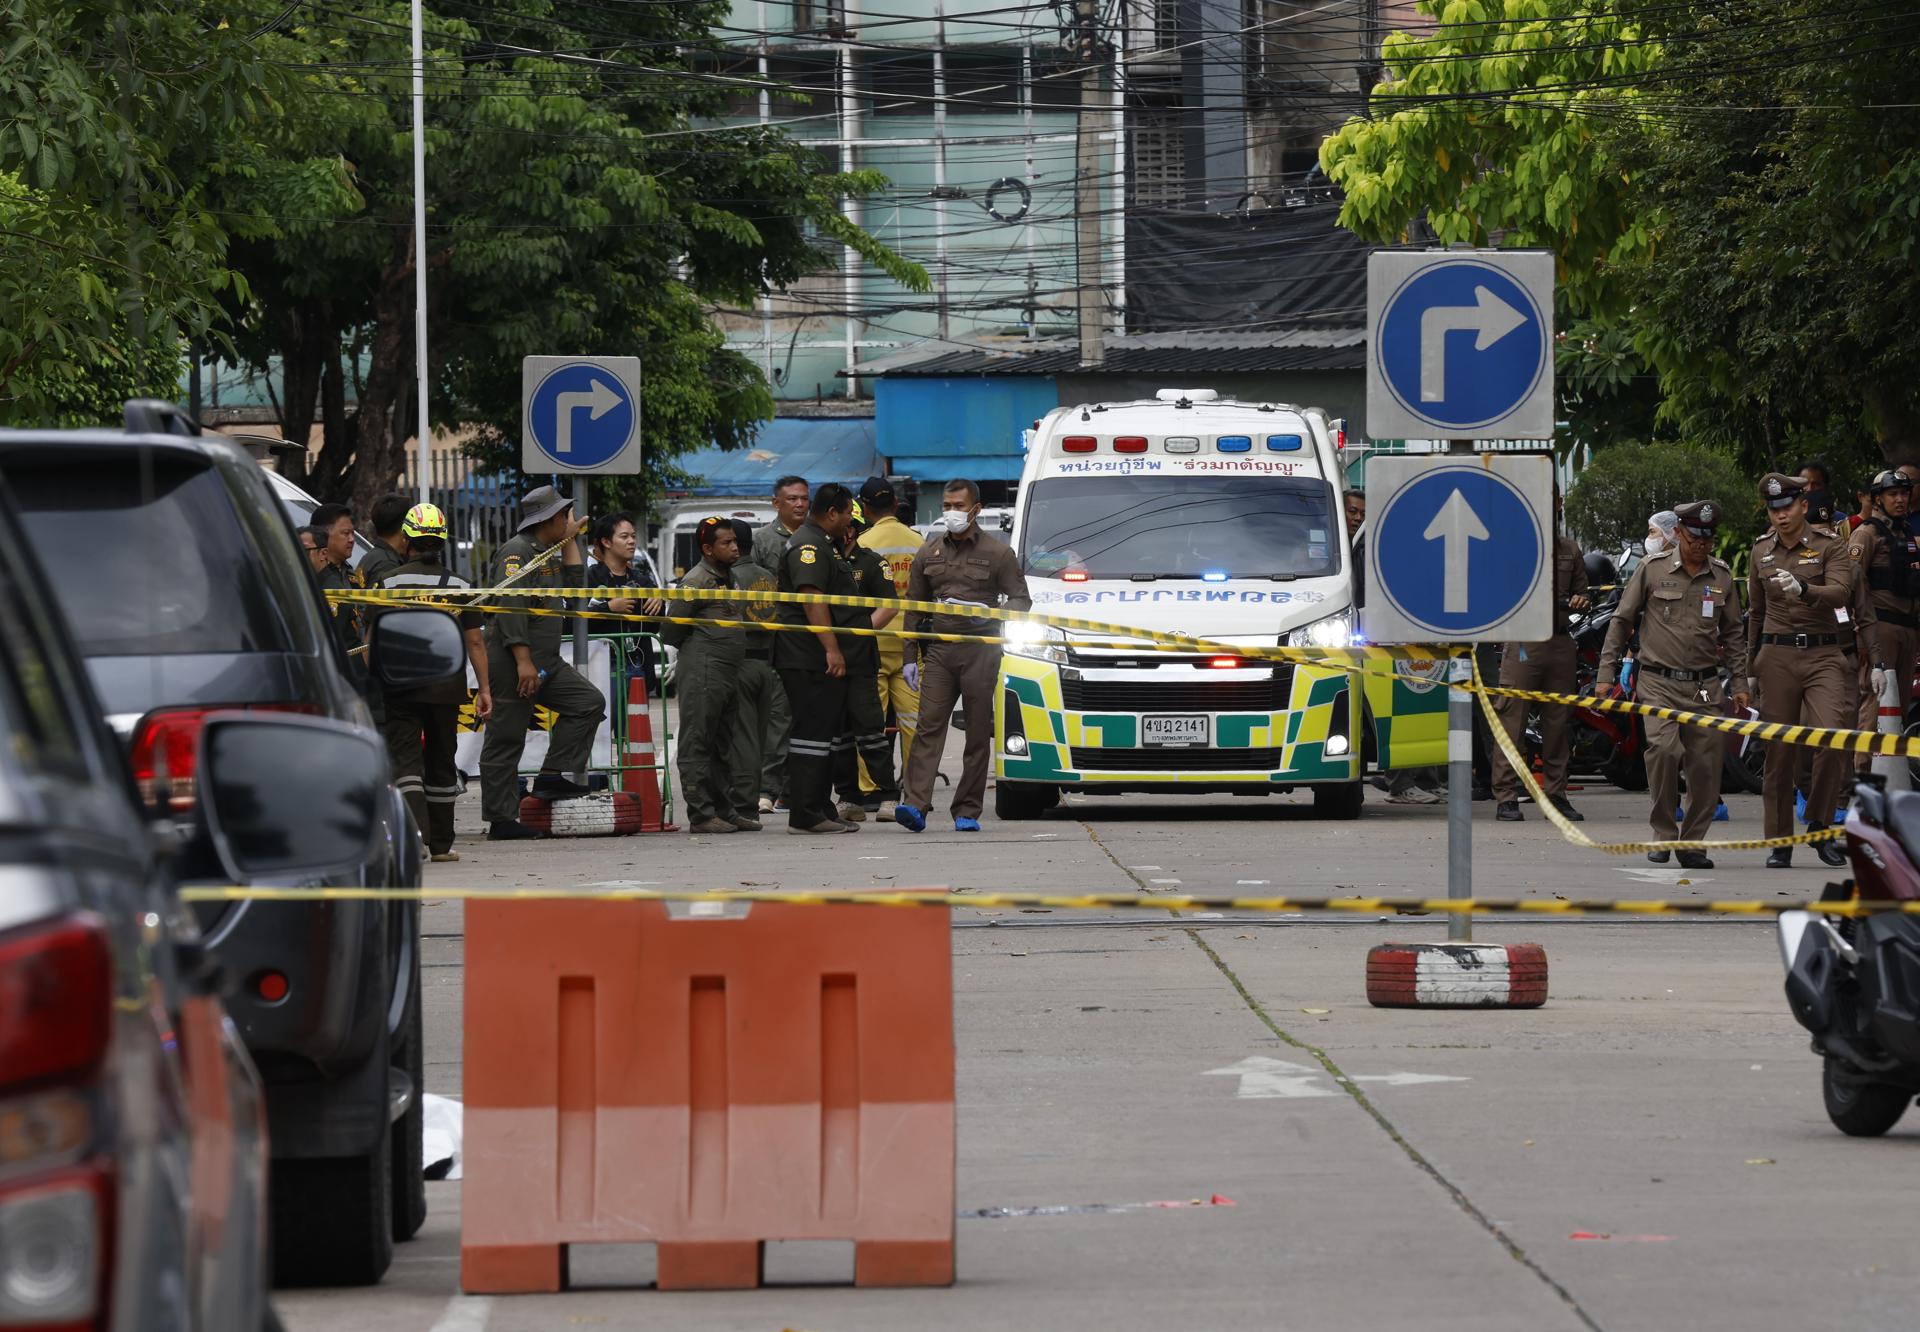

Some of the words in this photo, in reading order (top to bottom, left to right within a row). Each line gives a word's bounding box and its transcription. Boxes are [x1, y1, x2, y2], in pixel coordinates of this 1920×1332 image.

[1059, 457, 1162, 474] หน่วยกู้ชีพ
[1175, 720, 1204, 732] 2141
